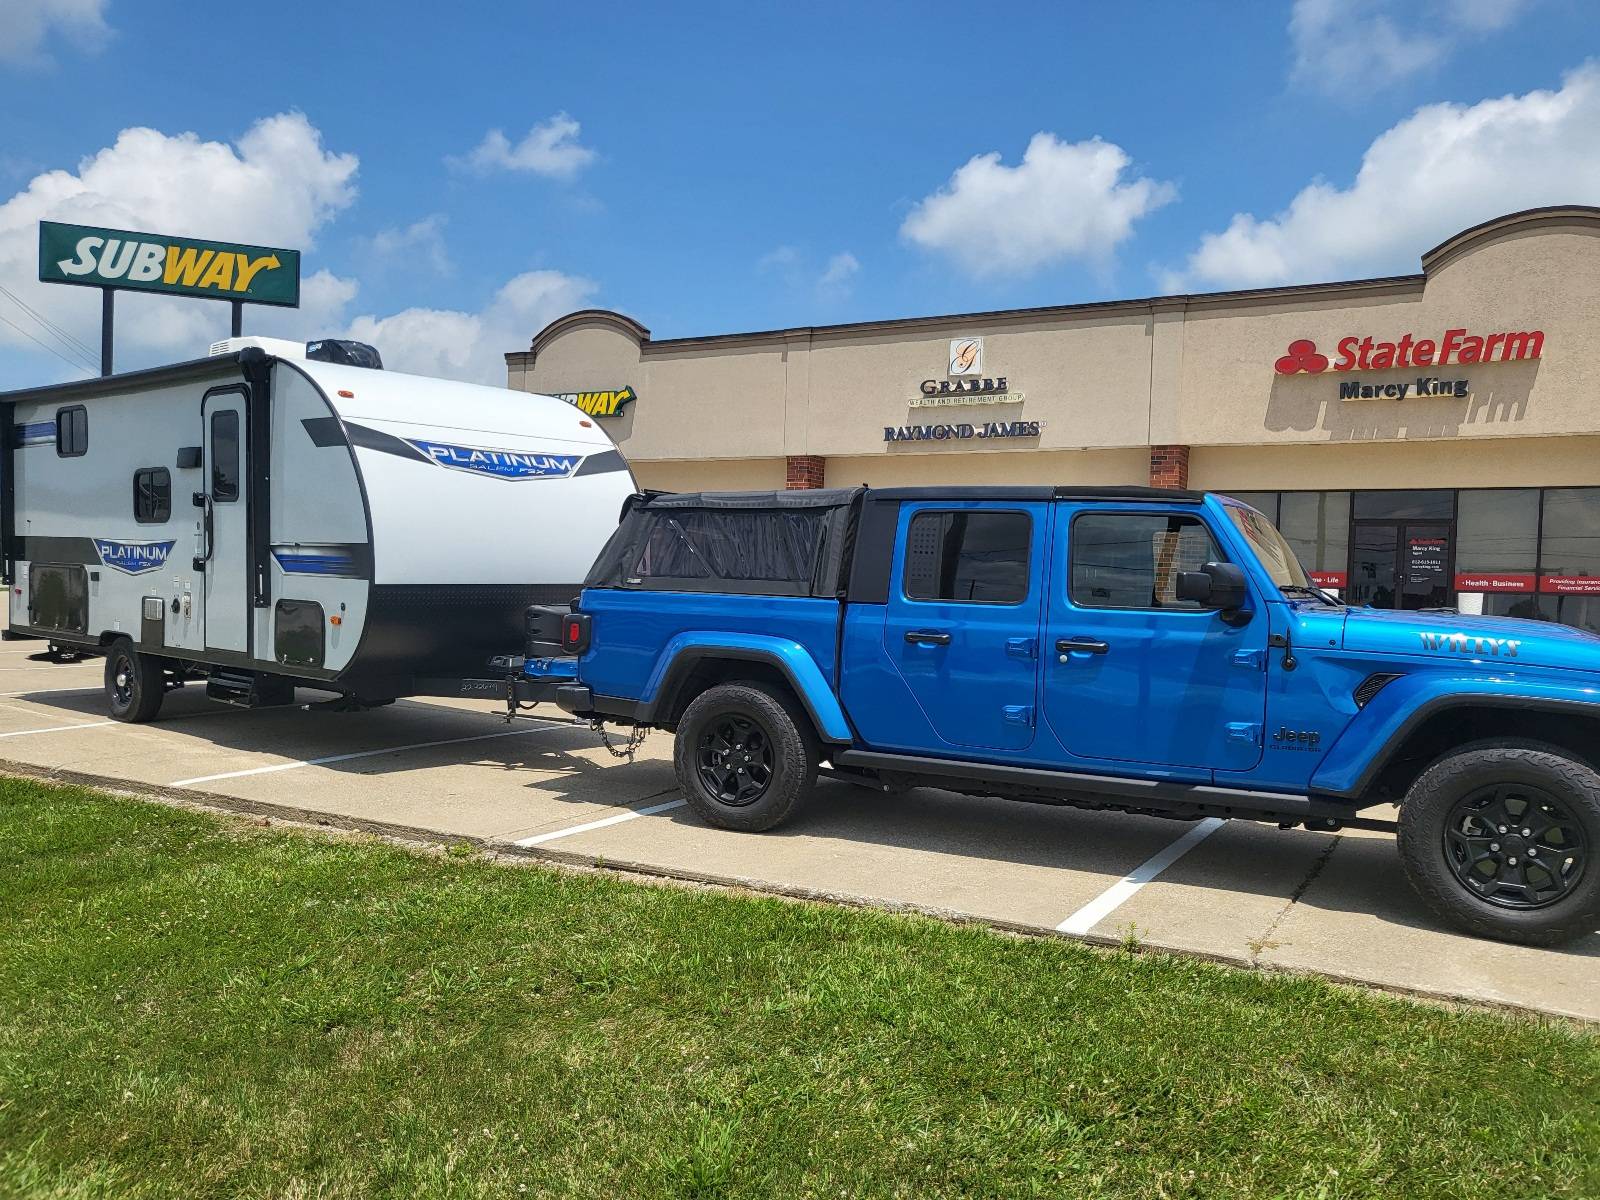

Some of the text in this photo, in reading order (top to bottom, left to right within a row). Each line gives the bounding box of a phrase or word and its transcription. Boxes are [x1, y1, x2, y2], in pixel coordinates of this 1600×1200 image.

[57, 236, 281, 292] SUBWAY
[1333, 328, 1544, 371] State Farm
[920, 377, 1007, 395] GRABBE
[1339, 378, 1469, 400] Marcy King
[553, 390, 631, 416] WAY
[909, 398, 935, 406] WEALTH
[954, 396, 995, 404] RETIREMENT
[883, 421, 1041, 442] RAYMOND JAMES
[428, 446, 572, 471] PLATINUM
[101, 545, 167, 561] PLATINUM
[1465, 579, 1525, 588] Health Business
[1419, 631, 1522, 658] WILLYS
[1272, 726, 1321, 747] Jeep
